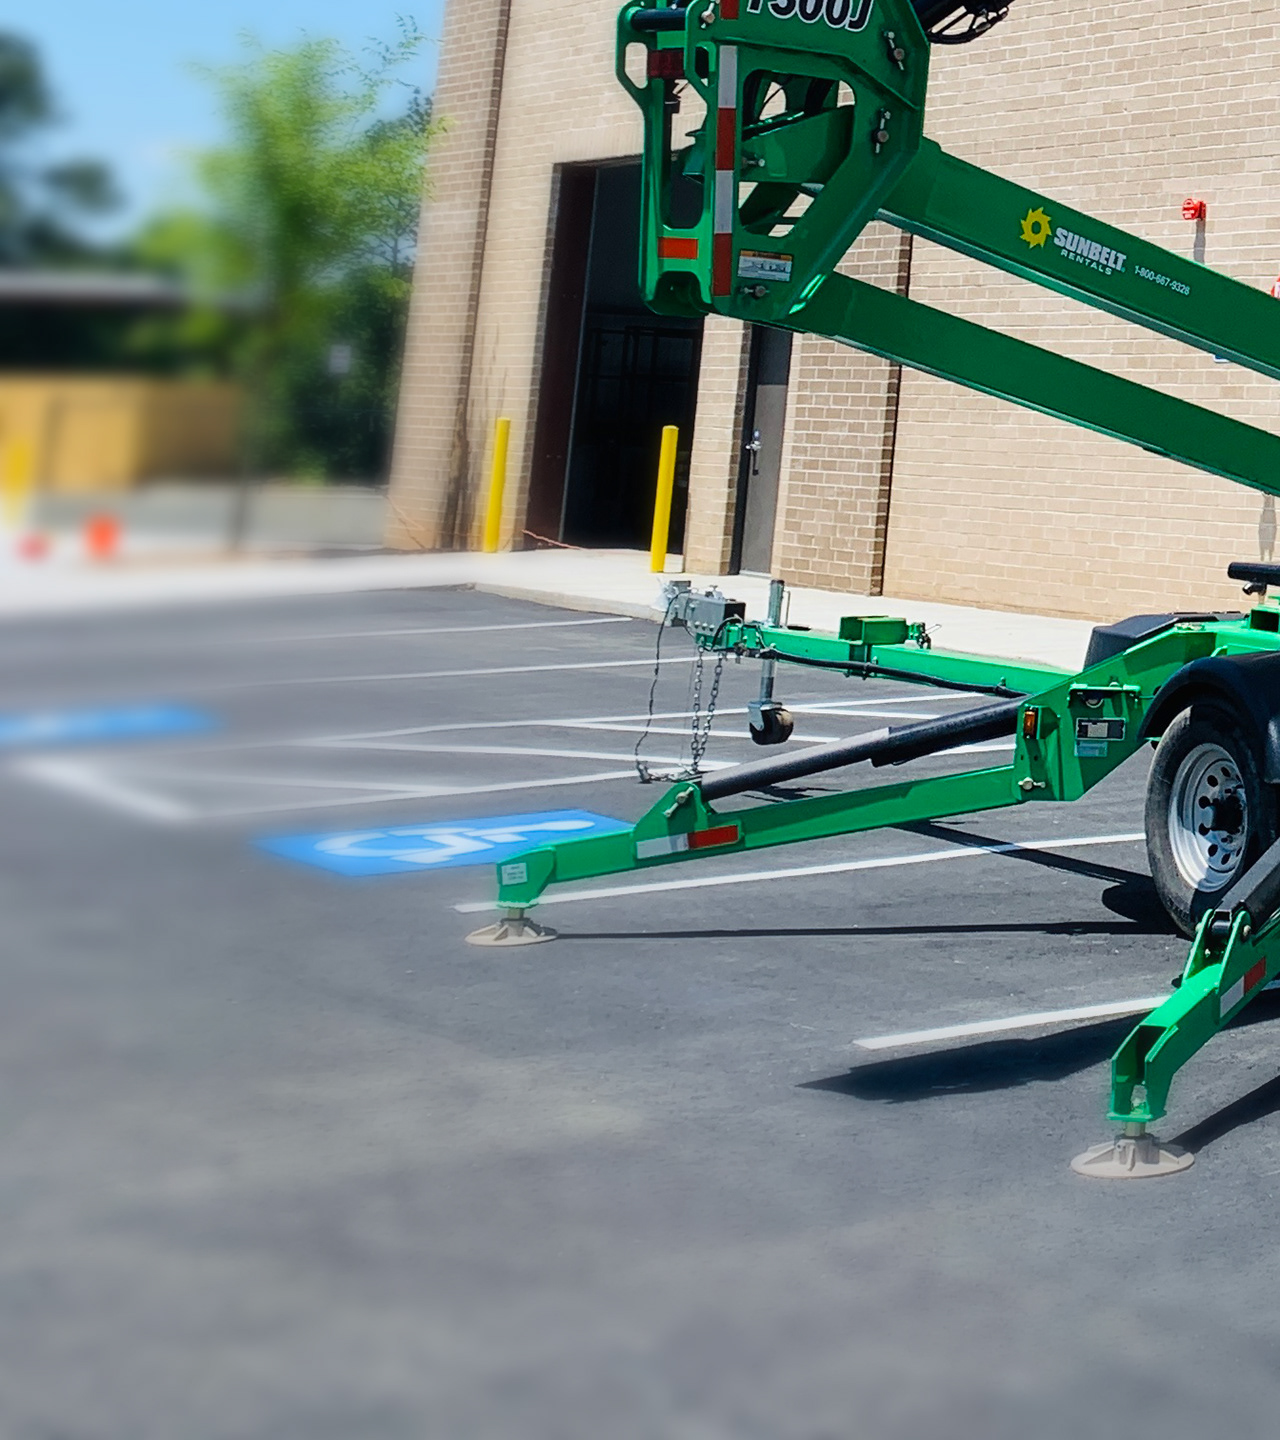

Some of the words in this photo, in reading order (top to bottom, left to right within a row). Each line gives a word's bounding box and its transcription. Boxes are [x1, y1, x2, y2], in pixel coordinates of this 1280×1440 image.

[1053, 227, 1127, 272] SUNBELT
[1060, 250, 1113, 276] RENTALS
[1134, 265, 1191, 296] 1-800-667-9328
